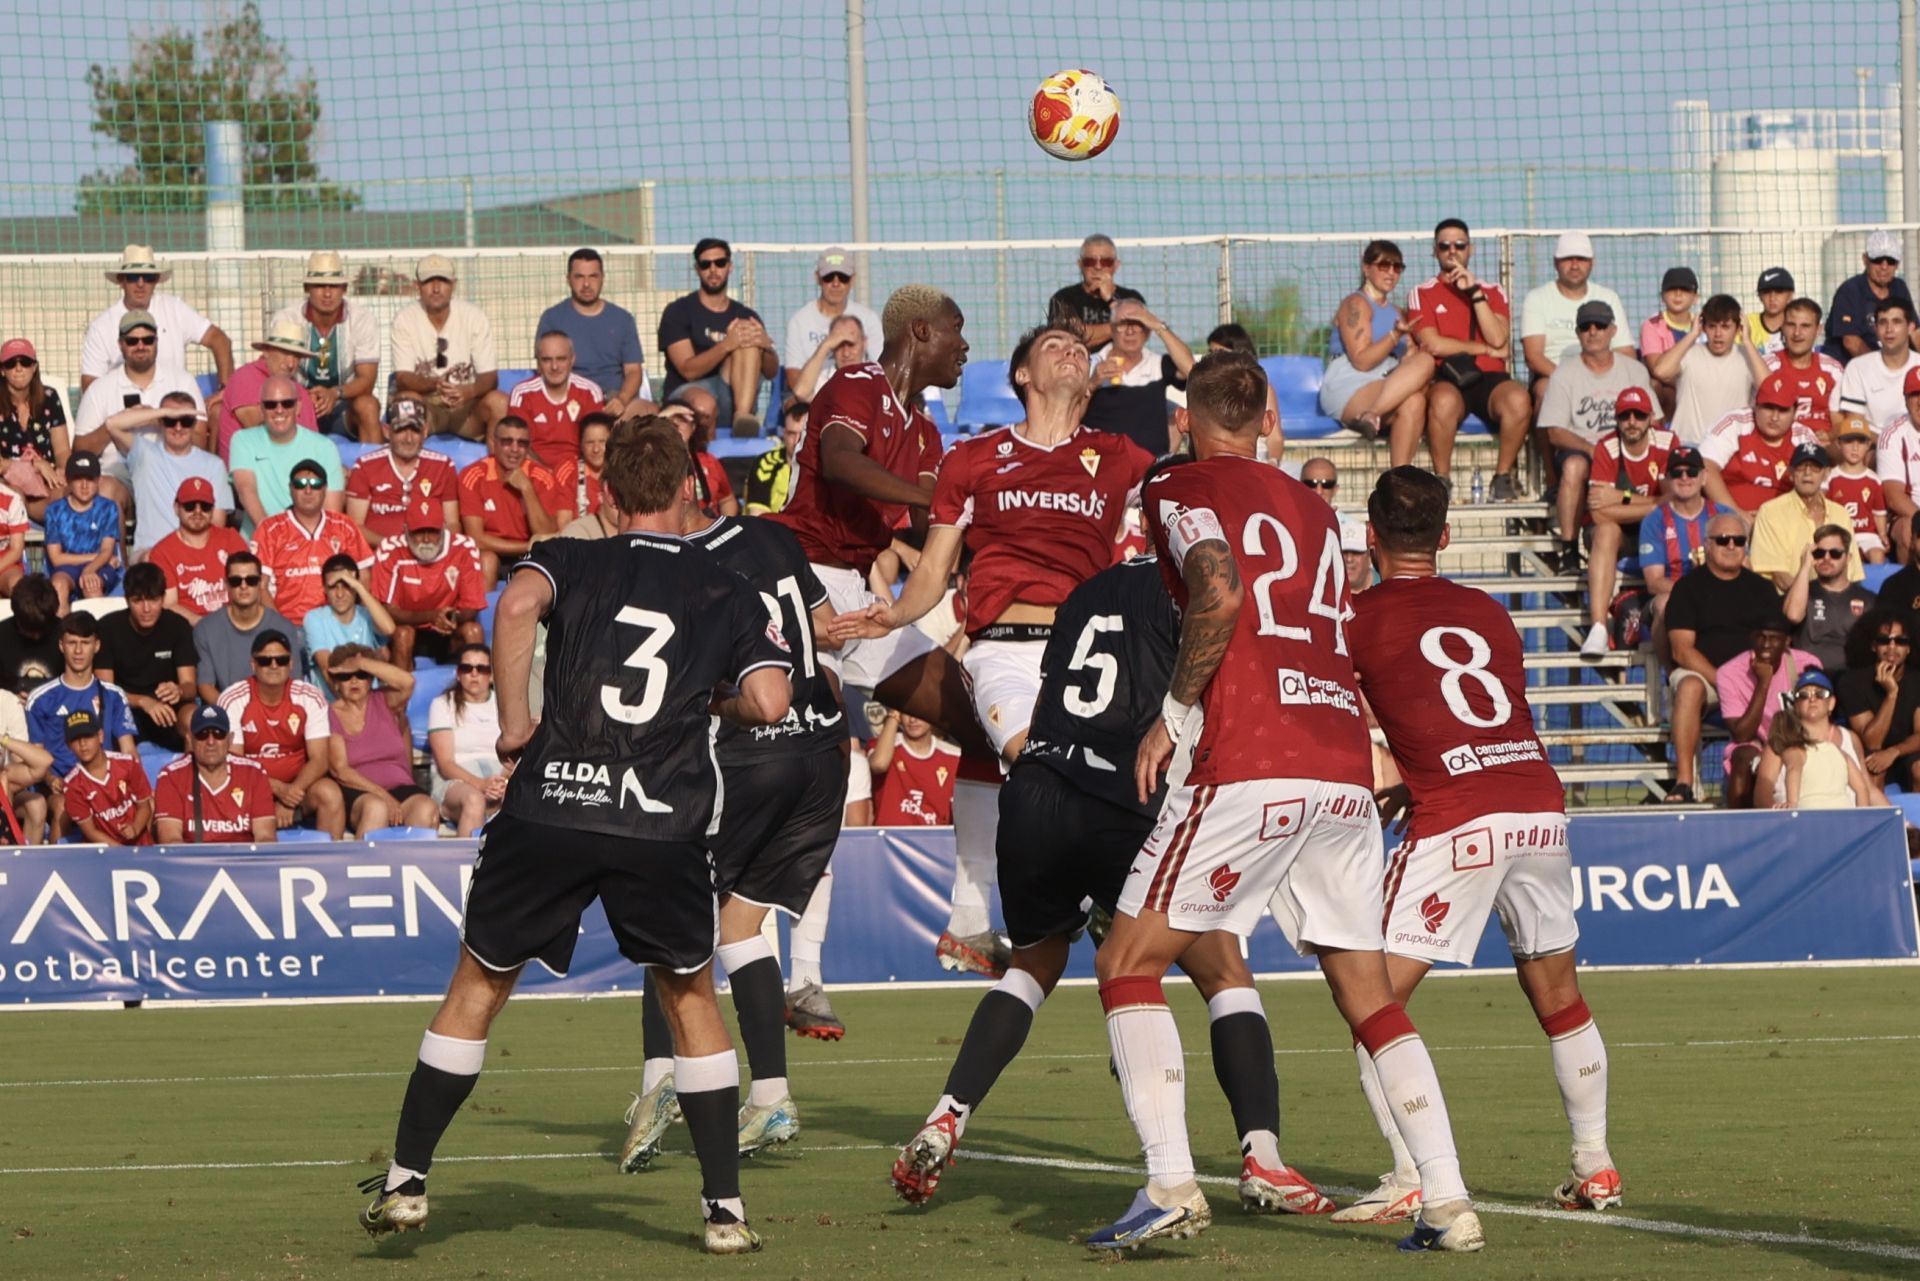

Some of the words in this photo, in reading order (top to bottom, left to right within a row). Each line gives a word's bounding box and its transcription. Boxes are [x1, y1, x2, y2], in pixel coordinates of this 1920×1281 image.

[997, 489, 1106, 520] INVERSUS
[1177, 515, 1201, 545] C
[1242, 512, 1356, 657] 24
[600, 605, 676, 725] 3
[1063, 614, 1124, 718] 5
[1420, 626, 1512, 729] 8
[1475, 740, 1539, 755] cerramientos
[544, 761, 611, 787] ELDA
[1449, 752, 1477, 771] CA
[552, 784, 576, 805] deja
[1504, 825, 1567, 850] redpis
[1395, 932, 1451, 948] grupolucas
[1578, 1060, 1601, 1078] RMU
